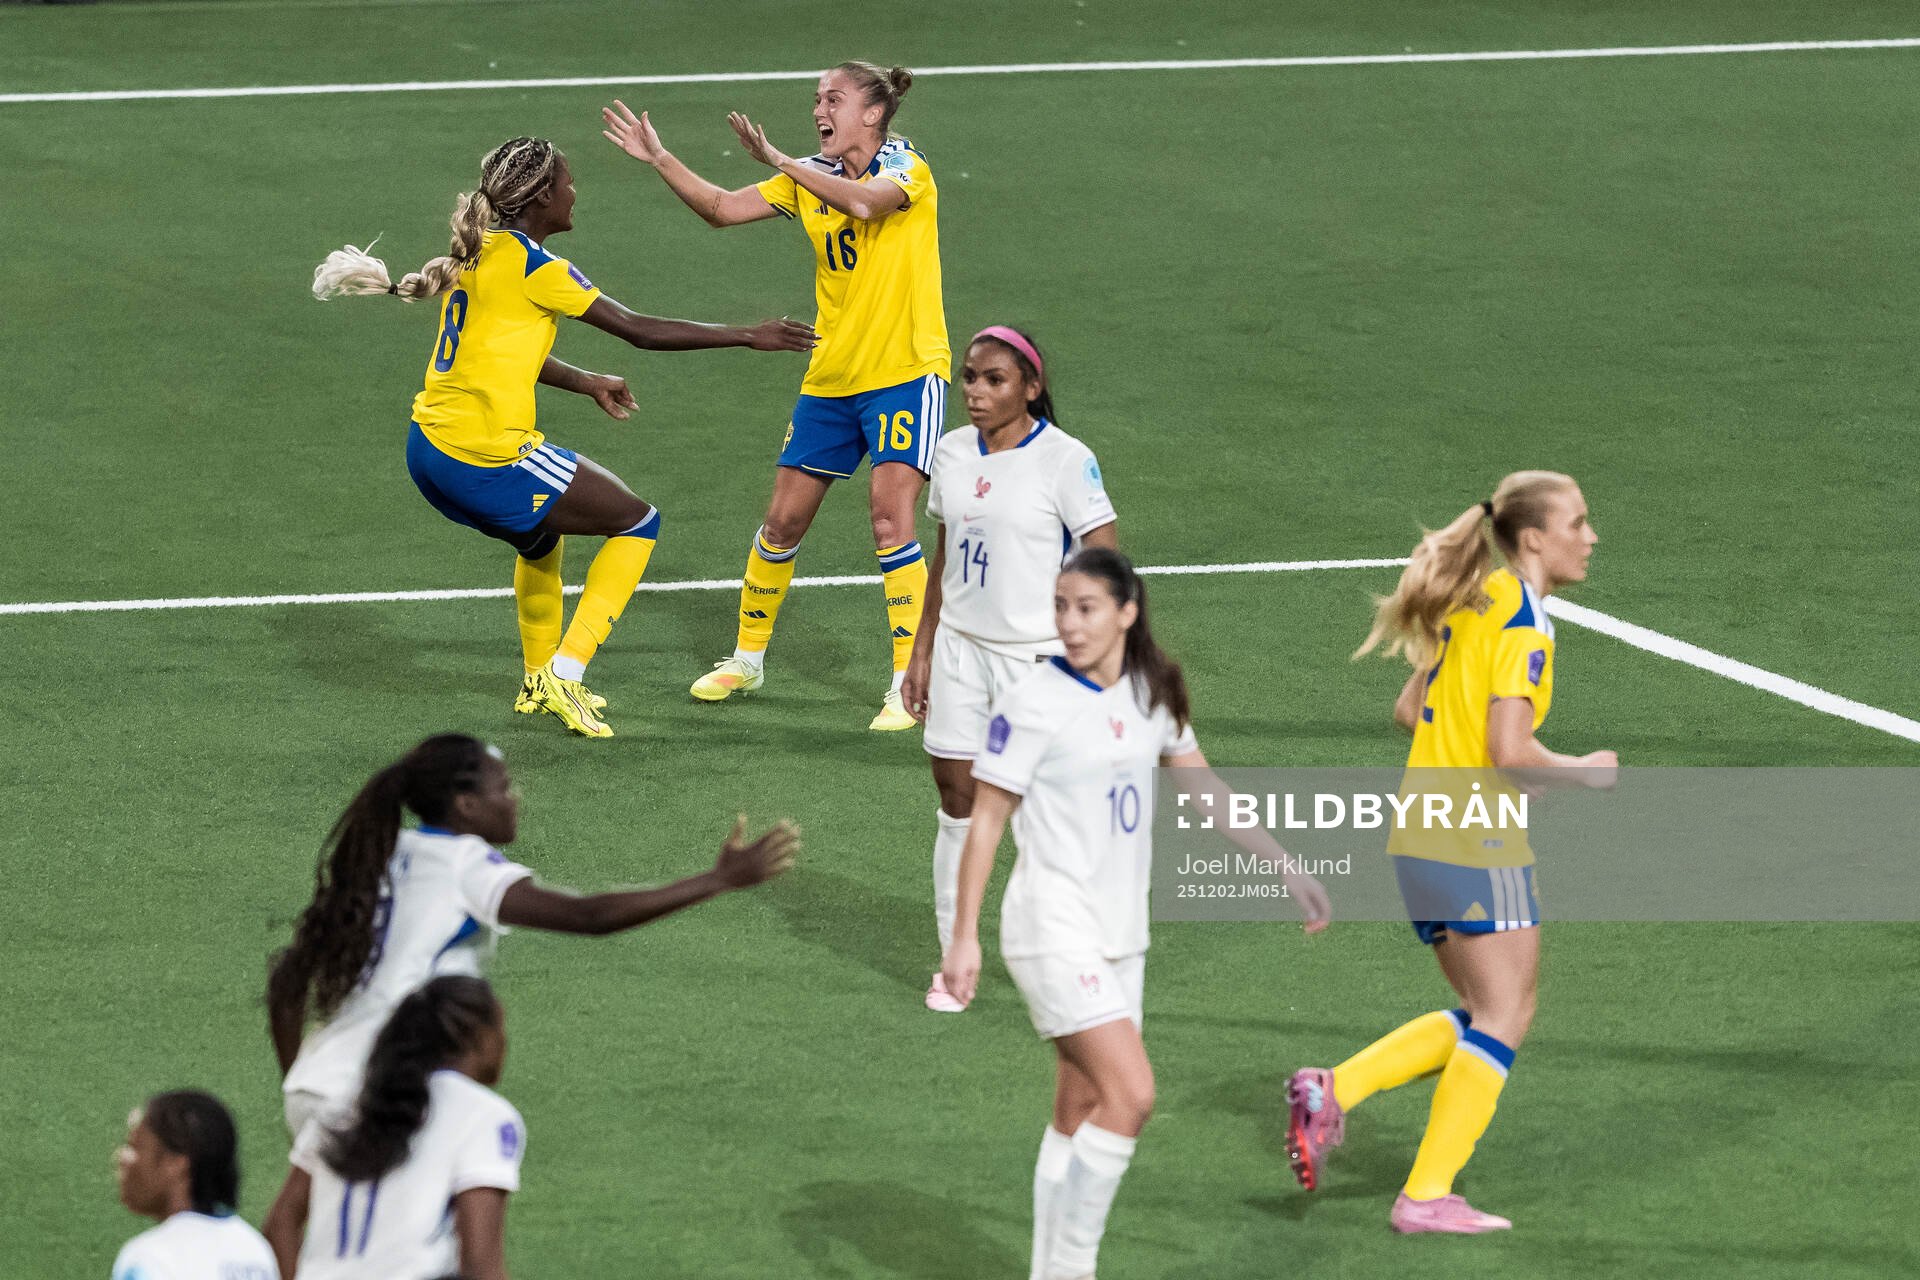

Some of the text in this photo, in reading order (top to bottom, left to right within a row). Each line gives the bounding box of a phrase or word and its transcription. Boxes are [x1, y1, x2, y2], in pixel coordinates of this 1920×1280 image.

[825, 228, 858, 272] 16
[434, 289, 469, 373] 8
[878, 409, 915, 453] 16
[958, 538, 989, 588] 14
[886, 594, 913, 607] ERIGE
[1106, 783, 1141, 837] 10
[336, 1178, 380, 1258] 11
